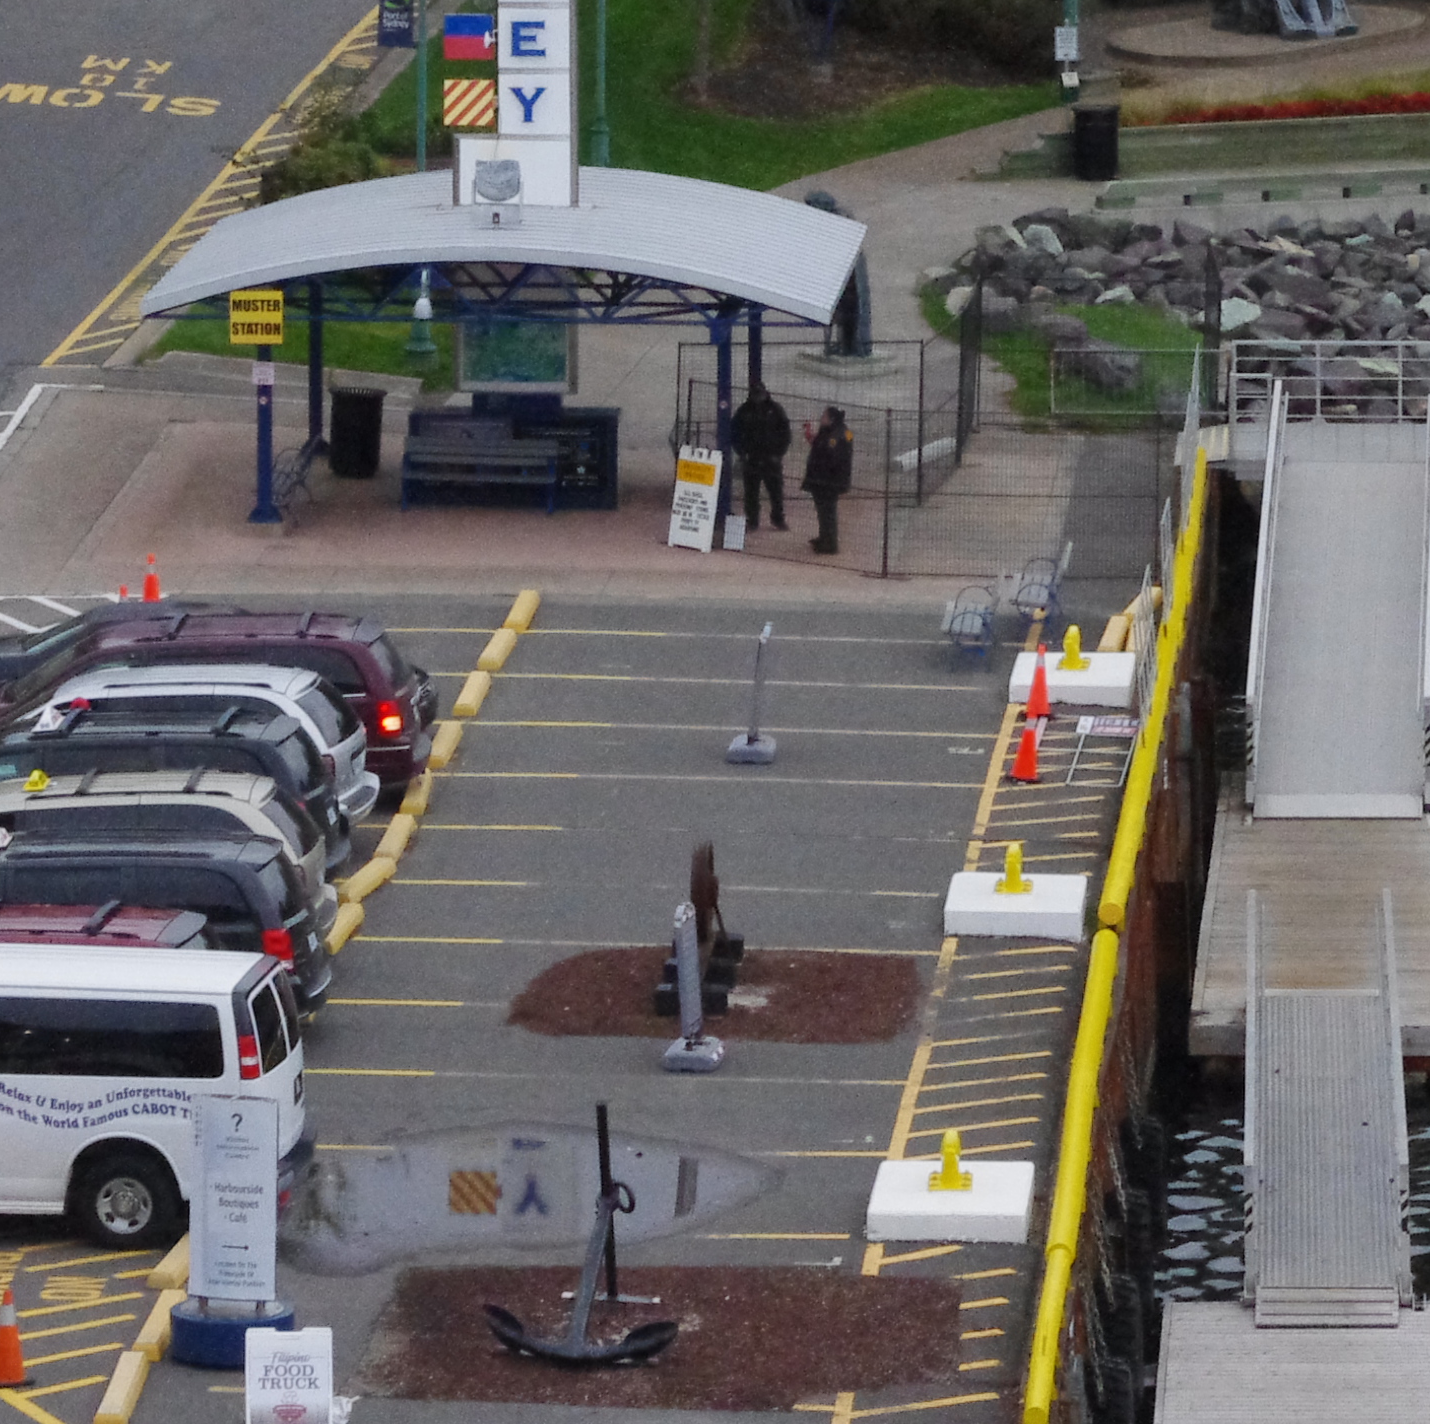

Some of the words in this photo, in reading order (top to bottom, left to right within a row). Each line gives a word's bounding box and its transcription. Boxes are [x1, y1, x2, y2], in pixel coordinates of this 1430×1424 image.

[383, 18, 409, 30] Sydney
[80, 54, 173, 75] KM
[231, 299, 281, 313] MUSTER
[231, 321, 281, 336] STATION
[49, 1097, 85, 1114] Enjoy
[87, 1099, 103, 1110] an
[105, 1086, 192, 1104] Unforgettable
[17, 1109, 39, 1125] the
[41, 1113, 80, 1129] World
[82, 1107, 129, 1128] Famous
[131, 1102, 177, 1118] CABOT
[214, 1182, 264, 1195] Harbourside
[218, 1197, 260, 1210] Boutiques
[272, 1351, 311, 1365] Filipino
[262, 1364, 315, 1377] FOOD
[257, 1377, 321, 1390] TRUCK
